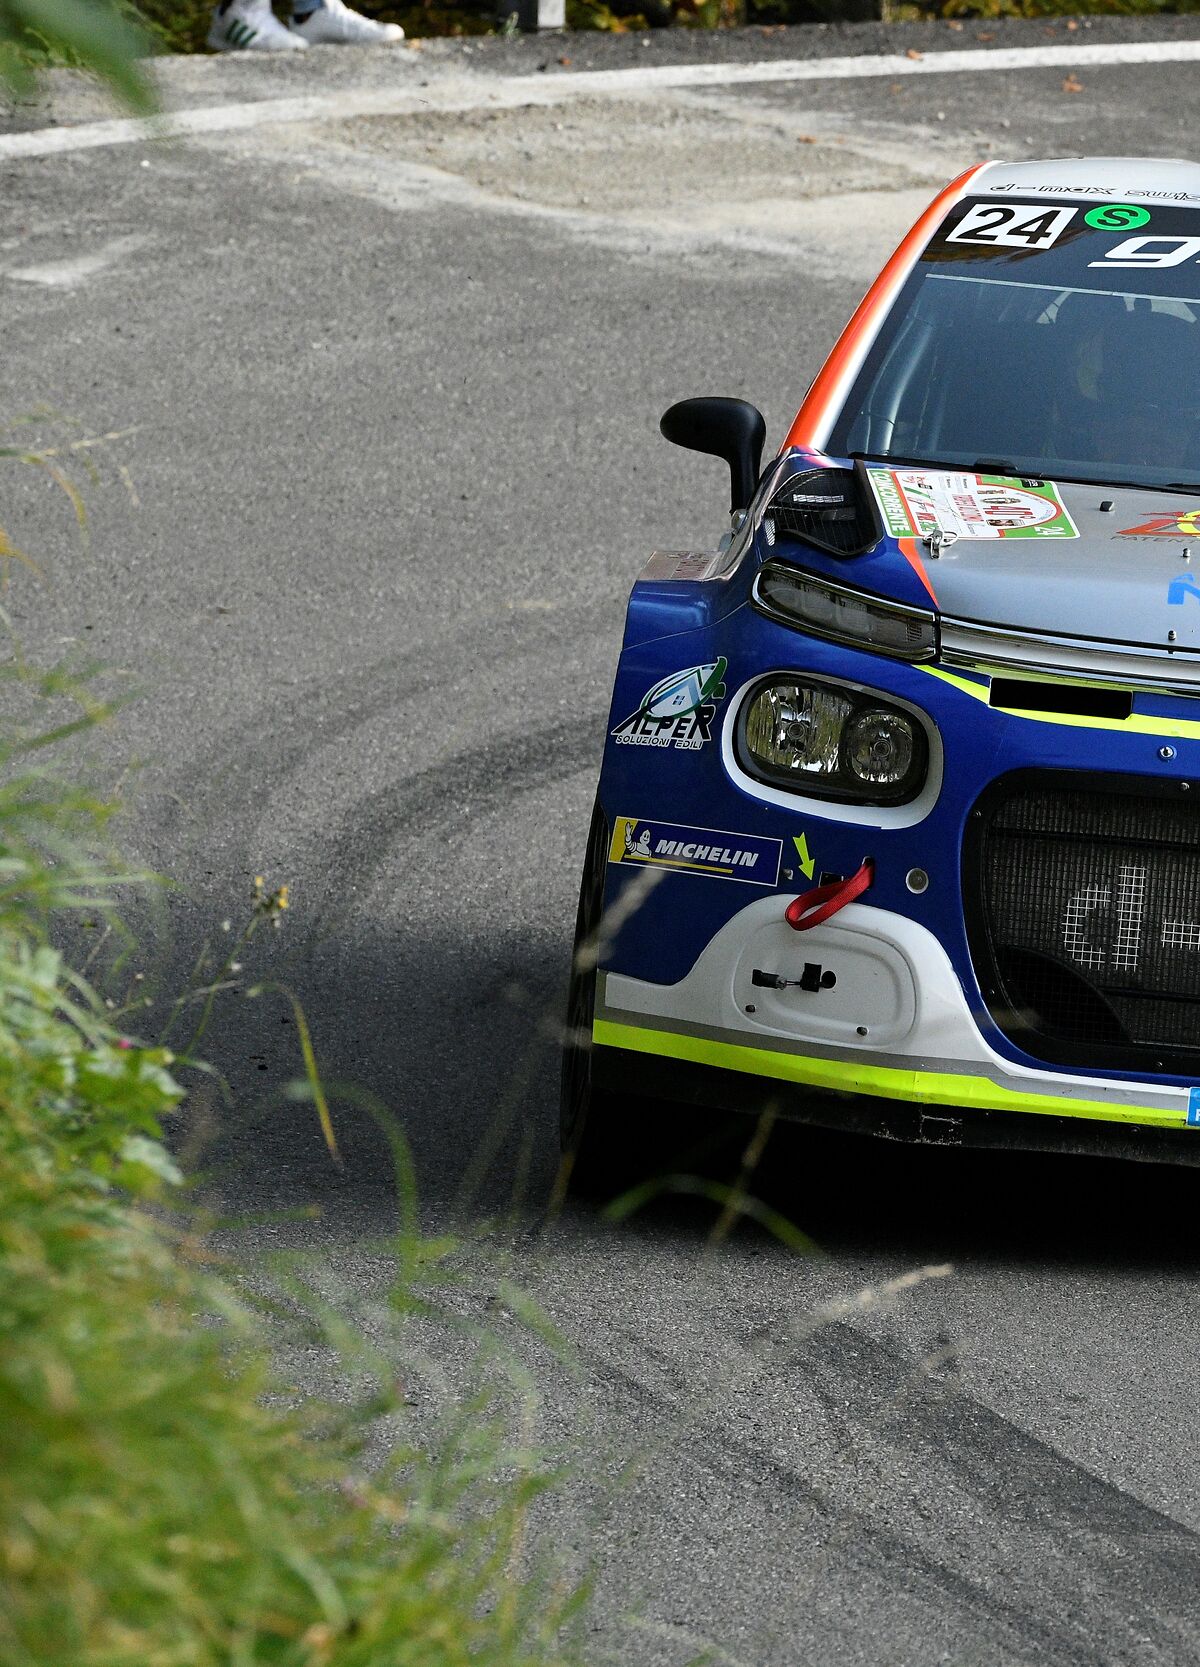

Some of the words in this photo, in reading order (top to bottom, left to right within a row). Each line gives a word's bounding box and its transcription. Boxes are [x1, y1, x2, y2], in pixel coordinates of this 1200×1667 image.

[990, 183, 1116, 195] d-max
[956, 207, 1061, 244] 24
[1096, 208, 1139, 227] S
[873, 472, 911, 532] CONCORRENTE
[611, 704, 717, 741] ALPER
[616, 734, 670, 748] SOLUZIONI
[674, 739, 704, 750] EDILI
[655, 838, 760, 868] MICHELIN
